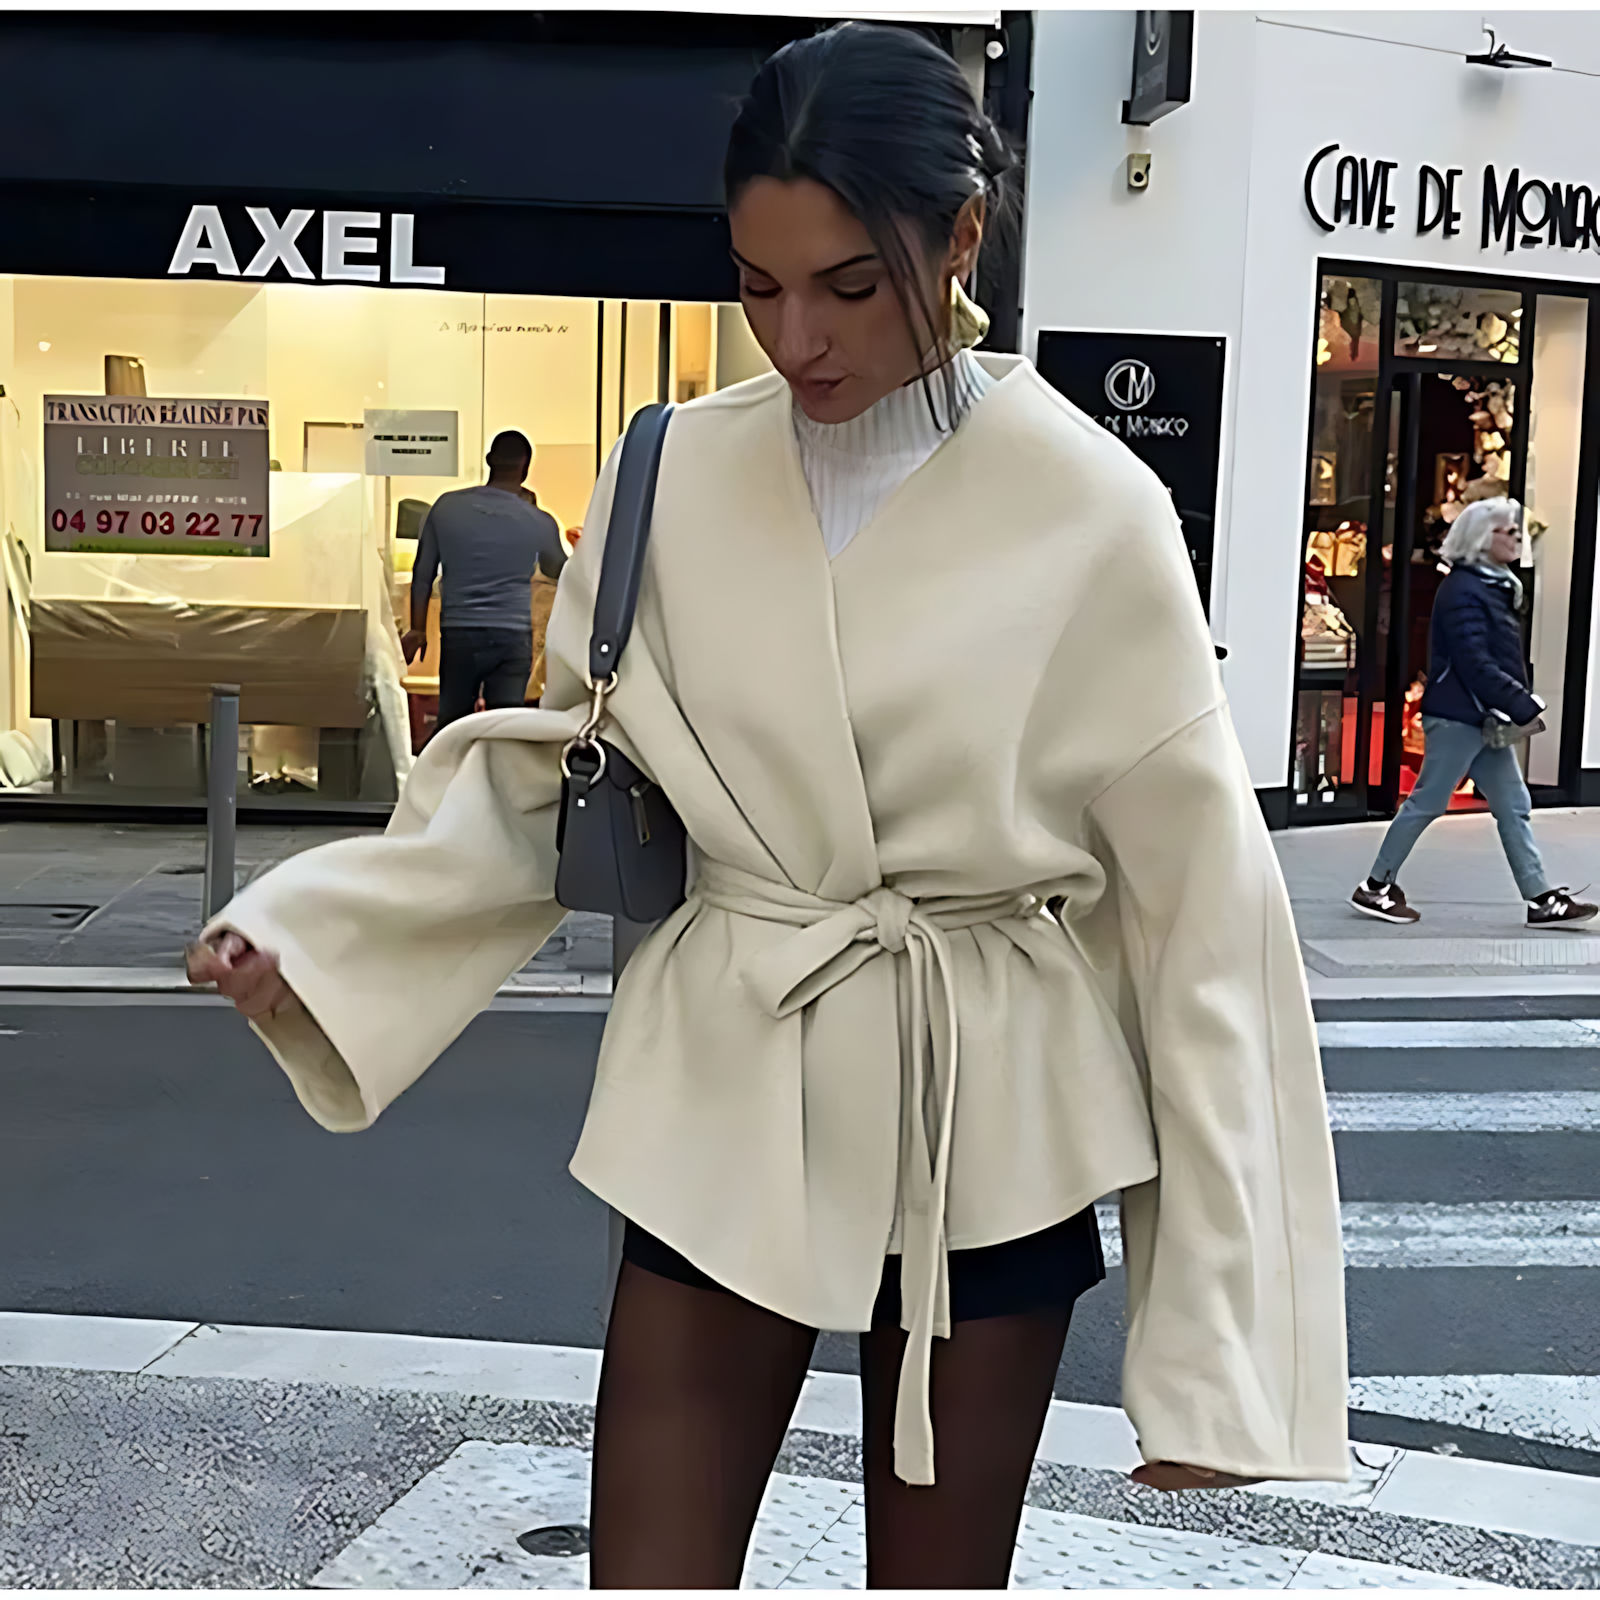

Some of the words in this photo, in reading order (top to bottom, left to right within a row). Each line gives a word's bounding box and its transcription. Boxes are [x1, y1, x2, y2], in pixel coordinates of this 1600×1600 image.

[1304, 144, 1398, 230] CAVE
[1417, 164, 1463, 235] DE
[167, 204, 446, 285] AXEL
[52, 508, 86, 534] 04
[96, 509, 130, 534] 97
[141, 510, 175, 535] 03
[185, 511, 220, 537] 22
[231, 513, 264, 538] 77
